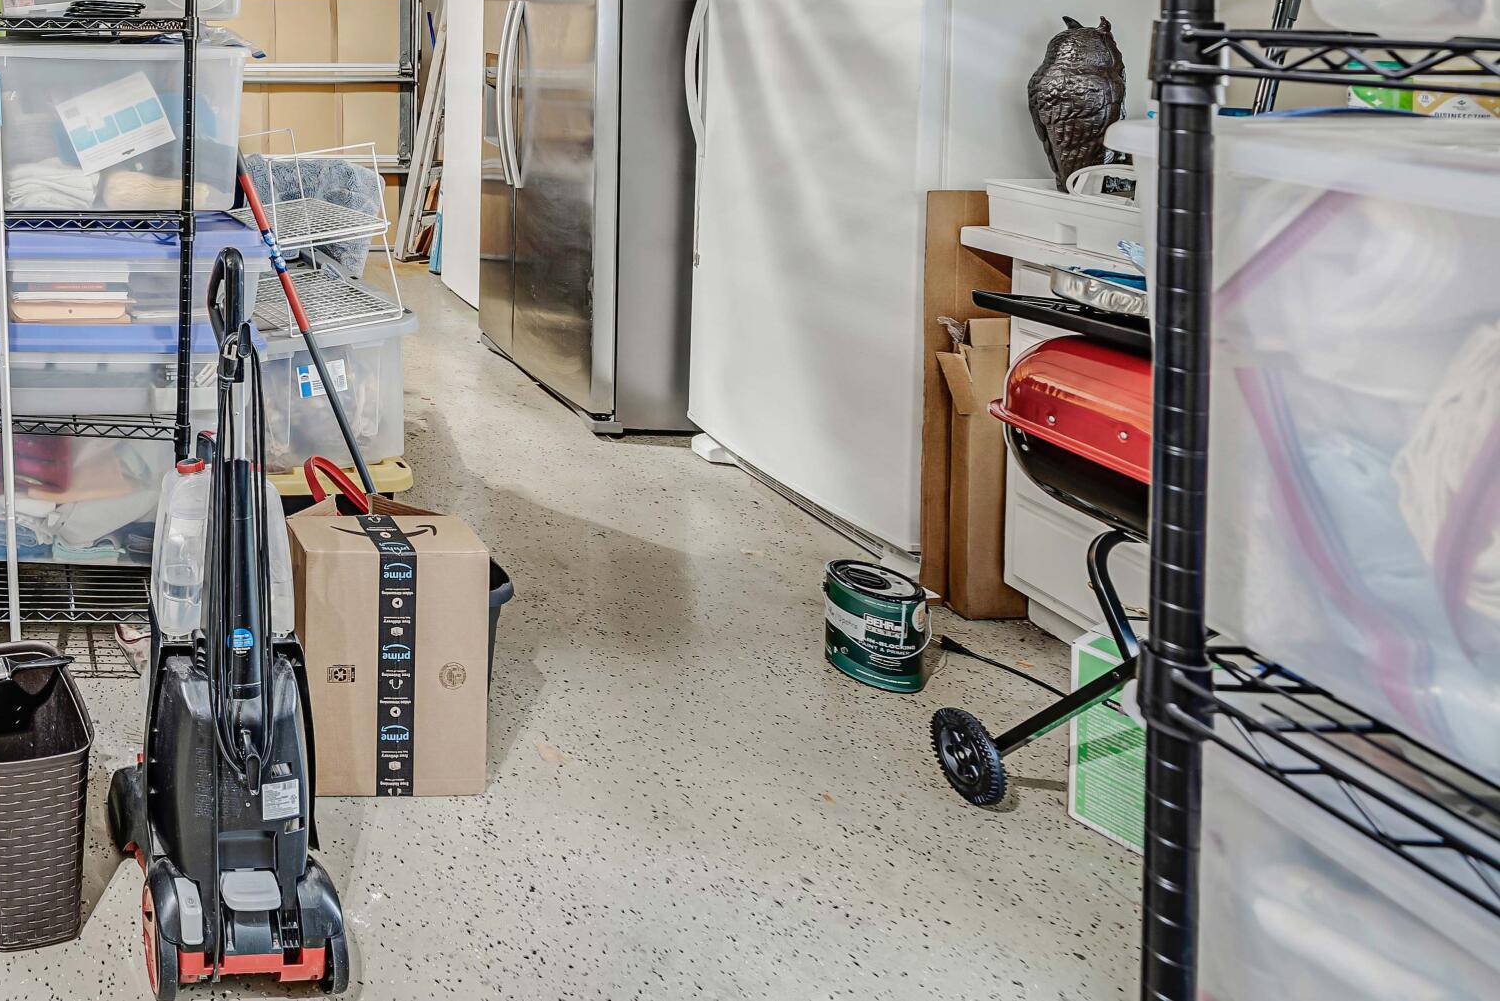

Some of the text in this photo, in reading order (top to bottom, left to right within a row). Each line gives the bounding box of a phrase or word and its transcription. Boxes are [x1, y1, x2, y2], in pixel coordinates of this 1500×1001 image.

[383, 571, 412, 581] prime
[866, 615, 895, 631] BEHR
[382, 651, 411, 662] prime
[380, 732, 409, 743] prime
